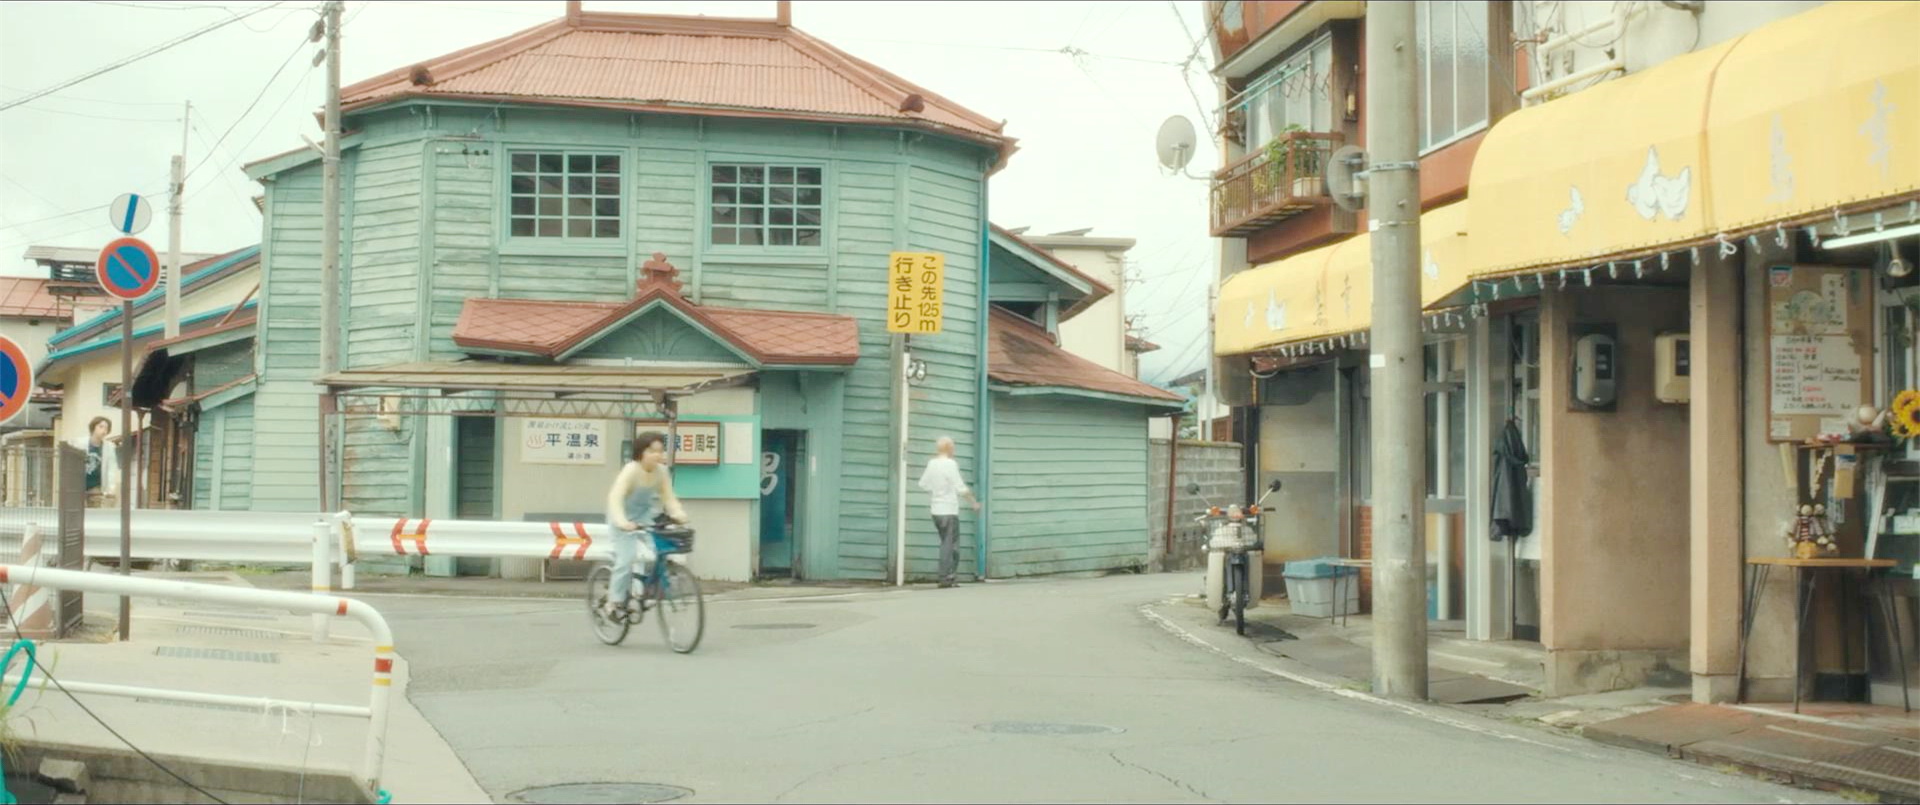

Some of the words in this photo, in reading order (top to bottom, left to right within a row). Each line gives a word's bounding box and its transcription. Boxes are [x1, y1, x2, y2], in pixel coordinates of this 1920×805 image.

[894, 256, 914, 328] 行き止り
[917, 256, 939, 332] この先125m
[545, 433, 599, 447] 平温泉
